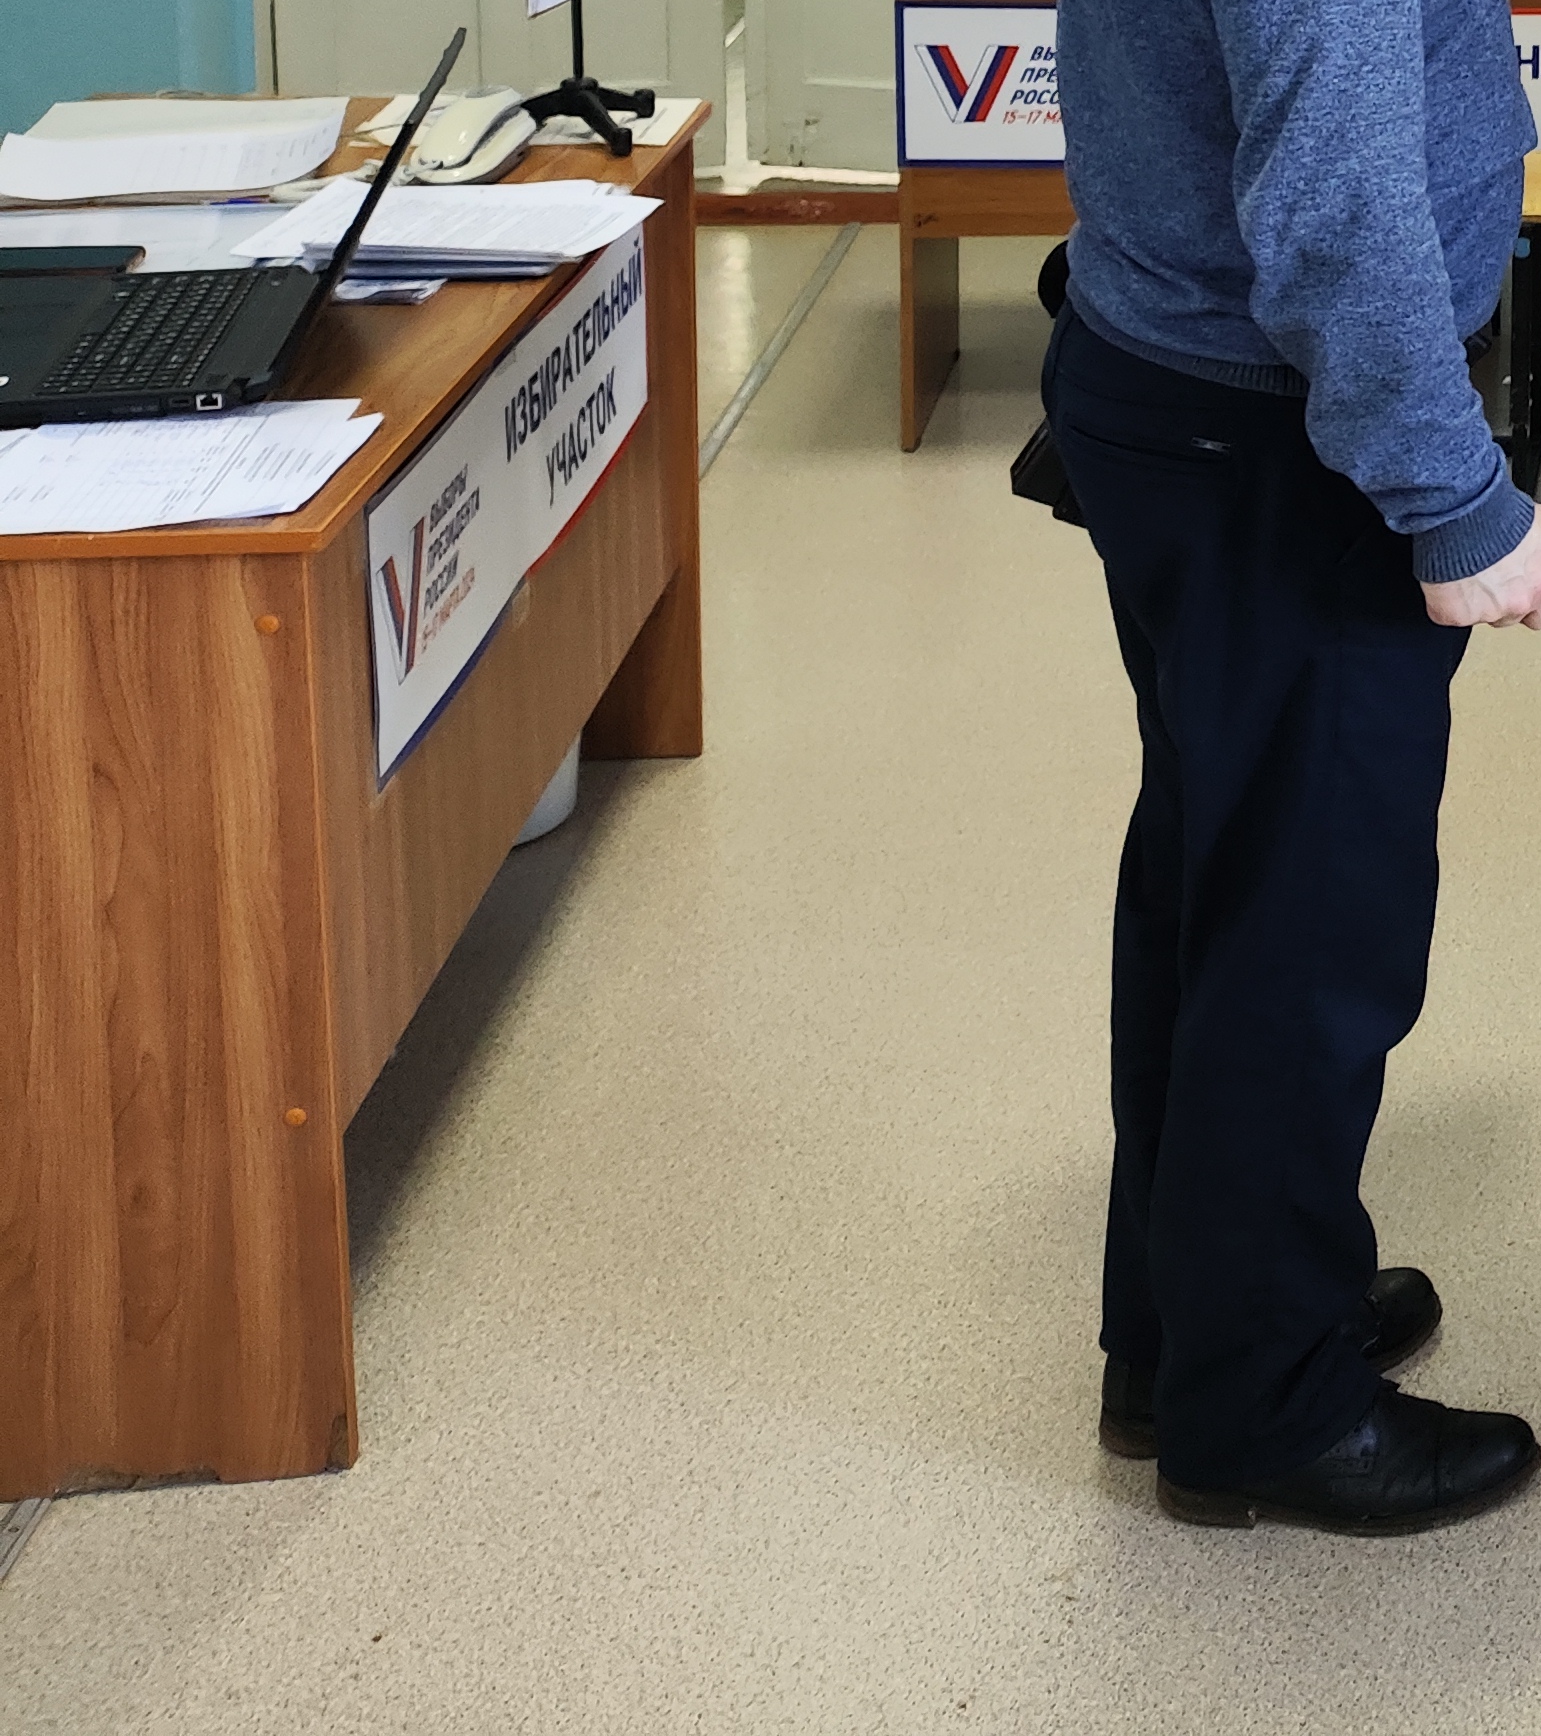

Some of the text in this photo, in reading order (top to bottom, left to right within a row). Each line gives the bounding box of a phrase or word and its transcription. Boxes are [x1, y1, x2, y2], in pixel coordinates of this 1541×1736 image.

[1010, 89, 1060, 105] РОСС
[1020, 67, 1058, 83] ПРЕ
[504, 237, 643, 462] ИЗБИРАТЕЛЬНЫЙ
[547, 366, 617, 510] УЧАСТОК
